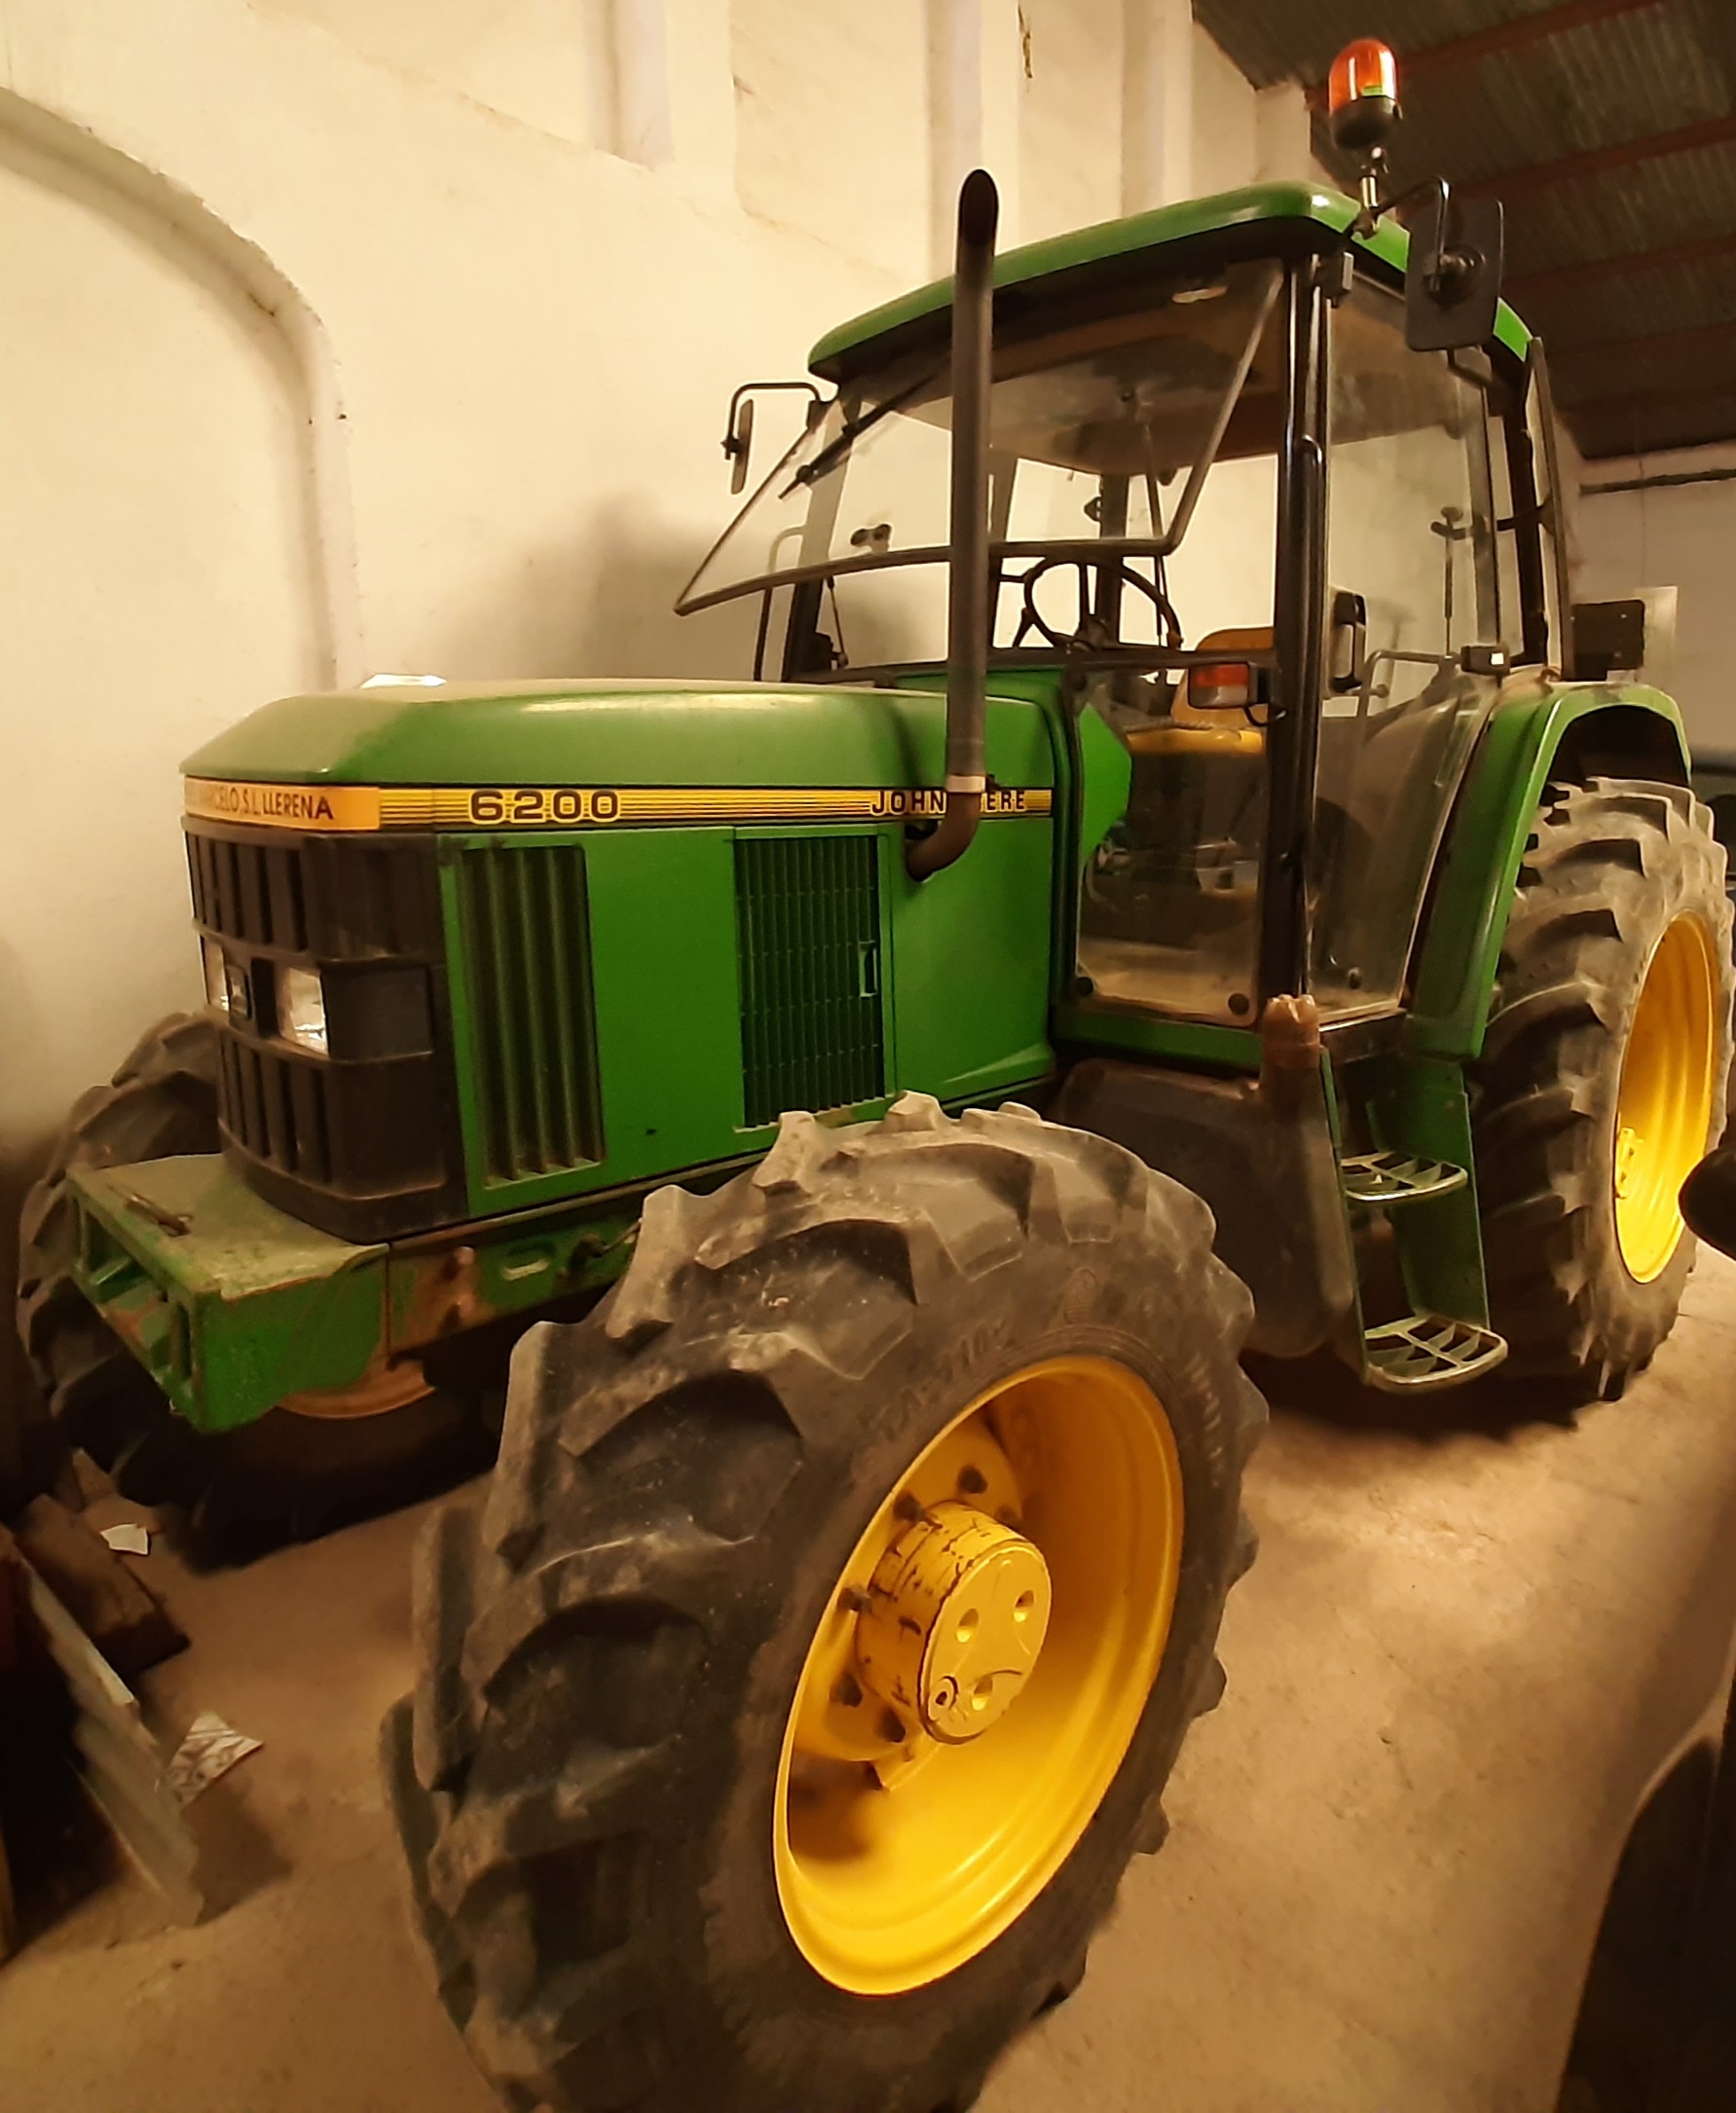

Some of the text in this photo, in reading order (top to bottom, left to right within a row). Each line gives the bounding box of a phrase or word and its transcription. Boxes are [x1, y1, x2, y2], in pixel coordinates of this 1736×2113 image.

[262, 792, 334, 820] LLERENA
[469, 789, 620, 824] 6200
[870, 790, 1026, 815] JOHN ERE
